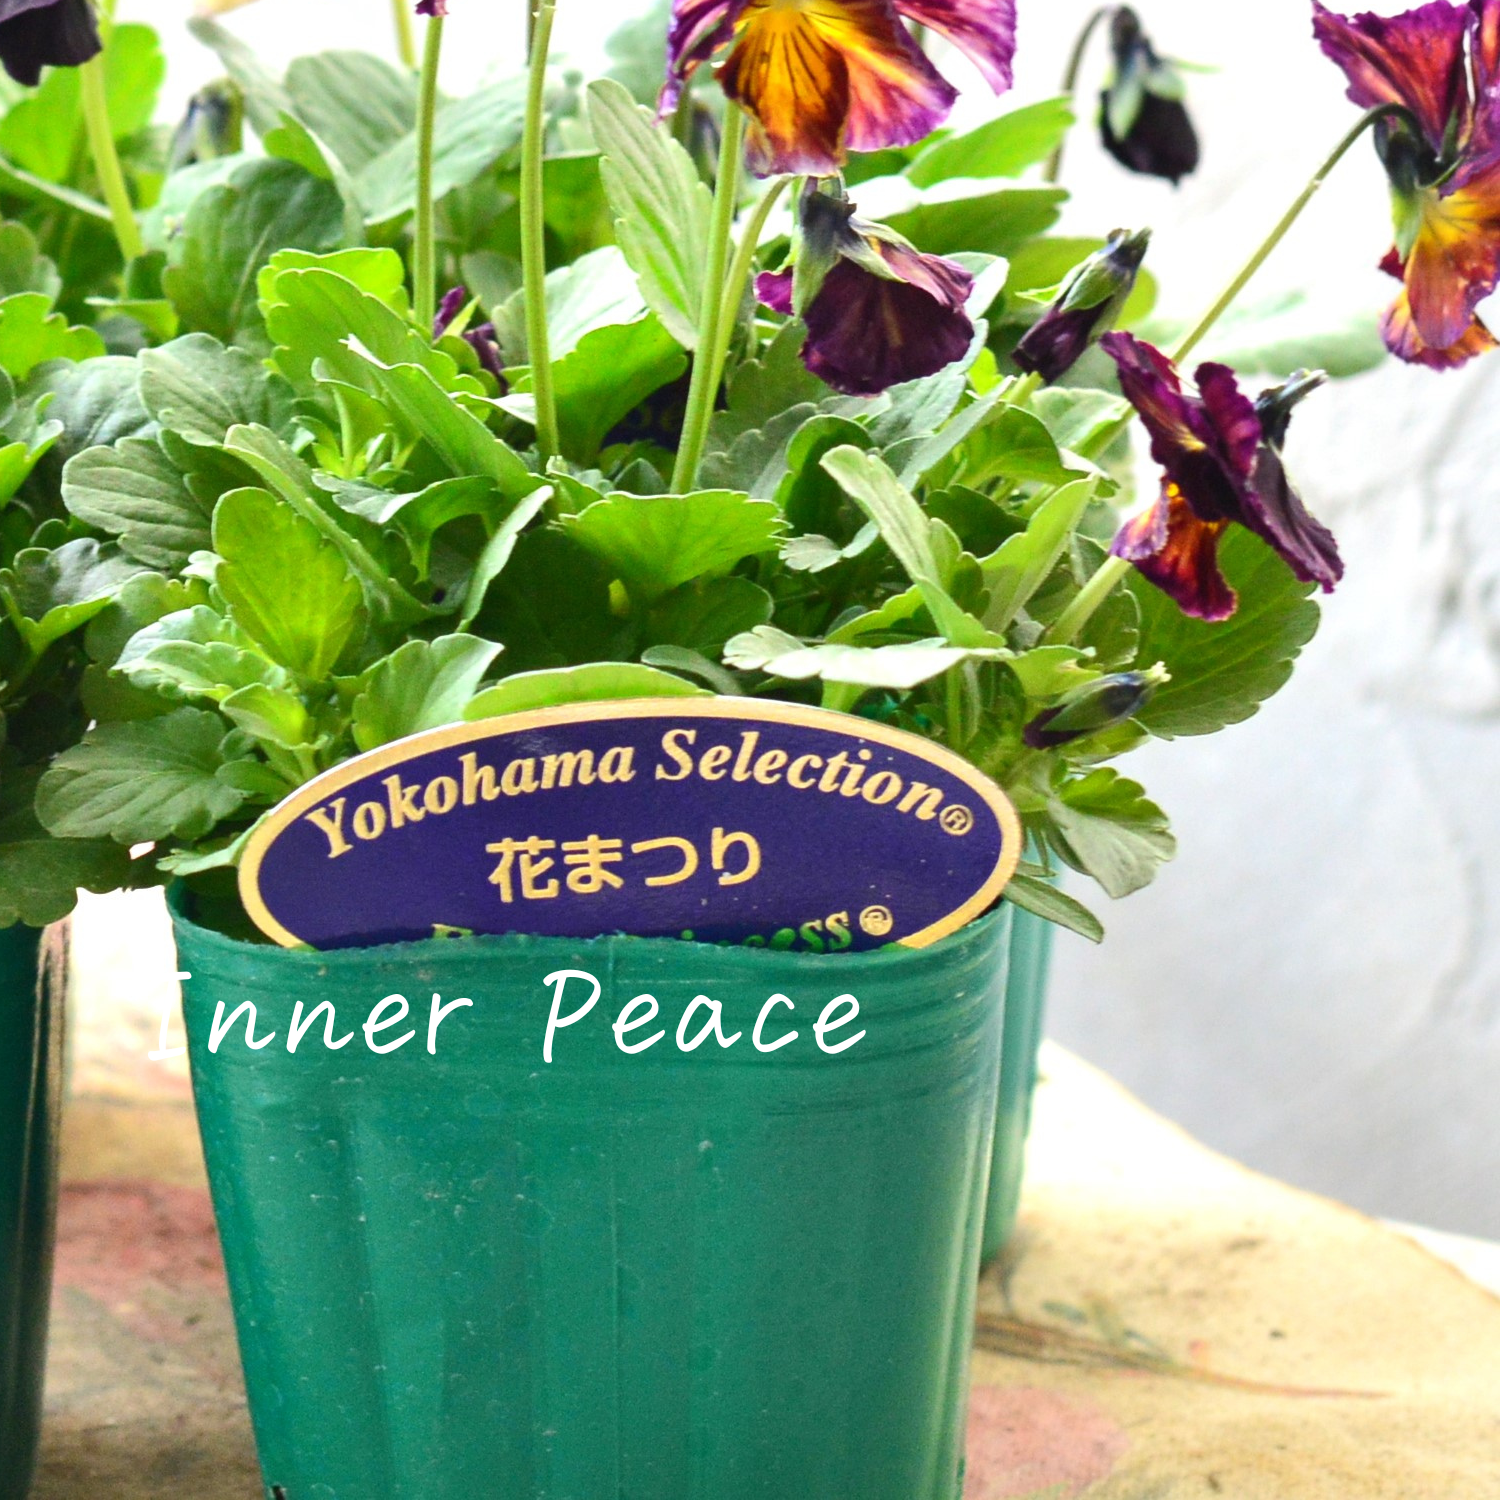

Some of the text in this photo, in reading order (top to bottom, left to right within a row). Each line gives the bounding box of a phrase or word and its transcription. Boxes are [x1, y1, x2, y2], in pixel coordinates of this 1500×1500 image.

[304, 744, 638, 860] Yokohama
[485, 826, 762, 904] 花まつり
